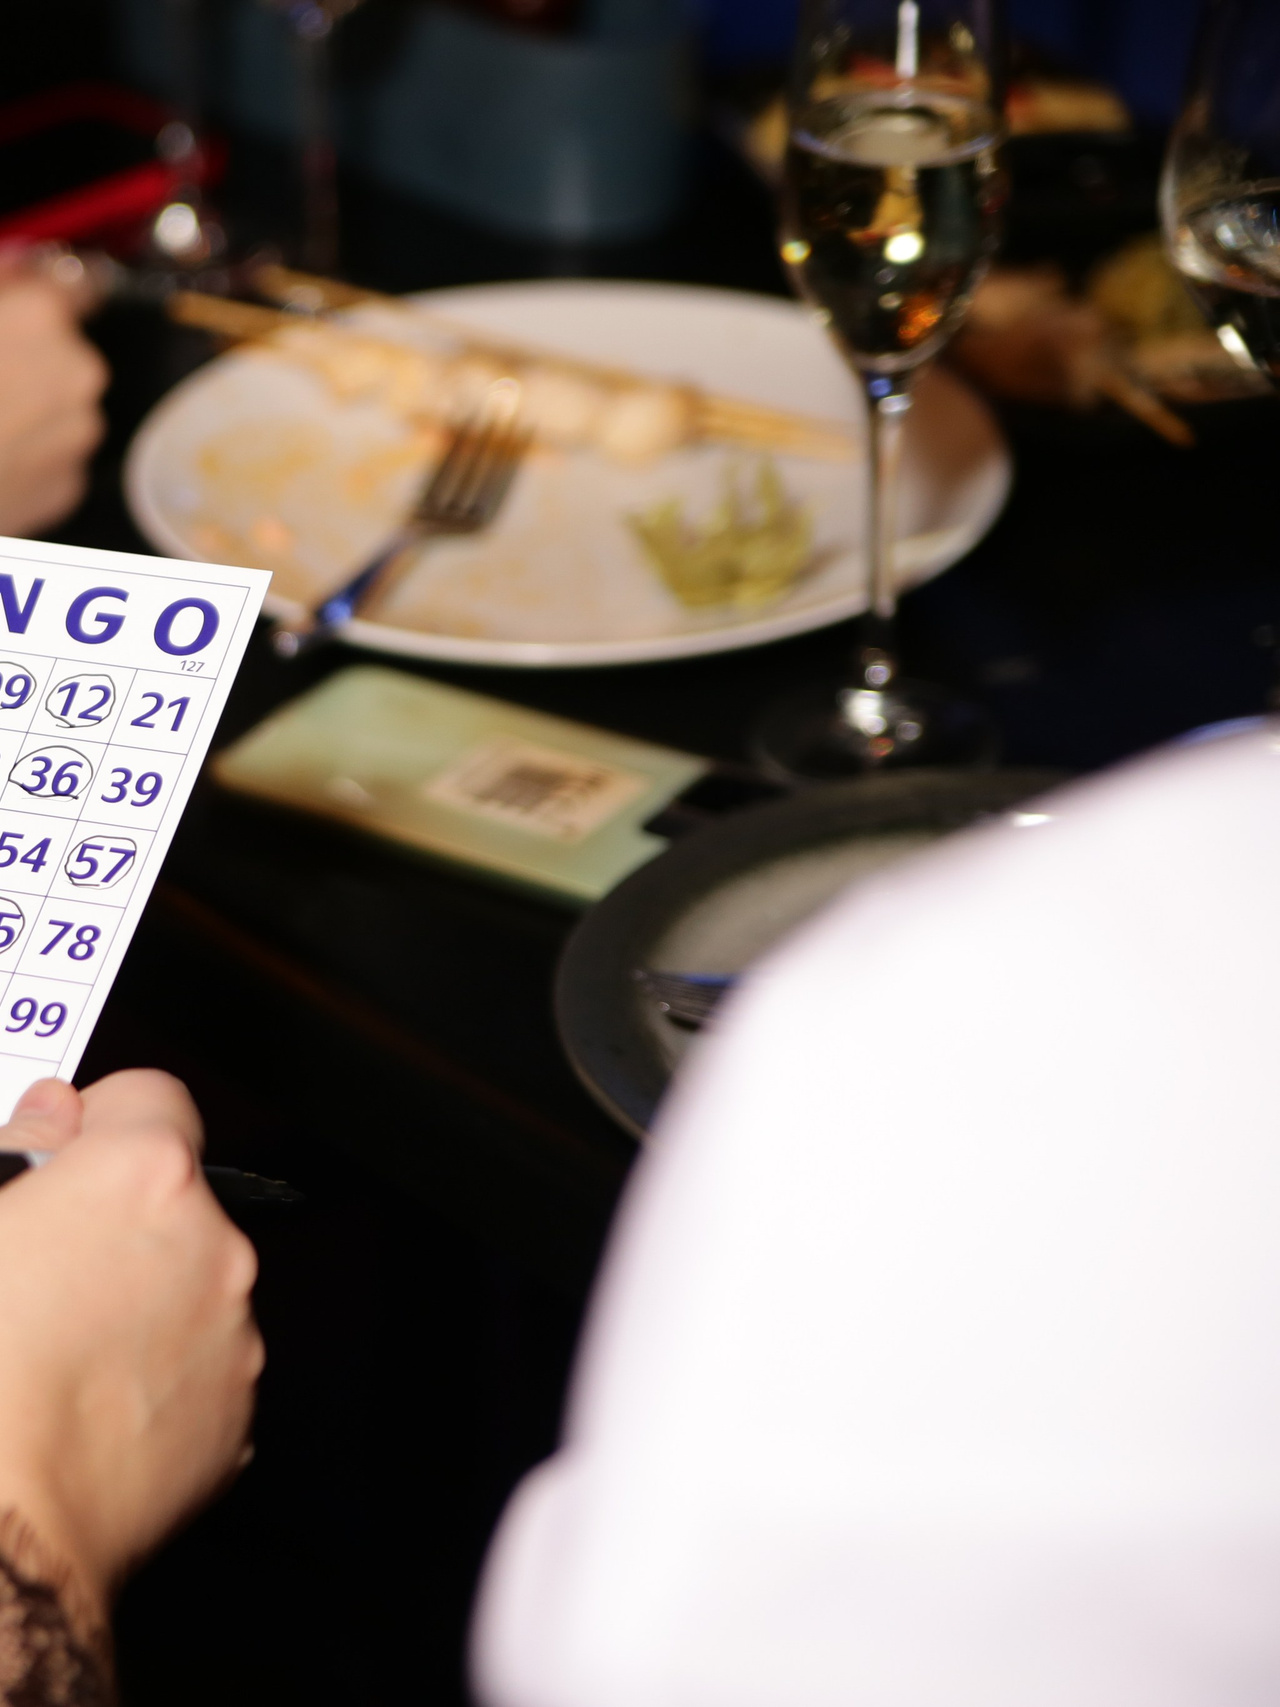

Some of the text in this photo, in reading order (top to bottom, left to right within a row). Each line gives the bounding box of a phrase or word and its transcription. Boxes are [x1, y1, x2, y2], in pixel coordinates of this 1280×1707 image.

[178, 660, 205, 674] 127
[56, 682, 110, 720] 12
[130, 692, 189, 731] 21
[20, 756, 82, 795] 36
[100, 767, 162, 807] 39
[68, 843, 135, 882] 57
[39, 919, 100, 960] 78
[4, 997, 67, 1037] 99
